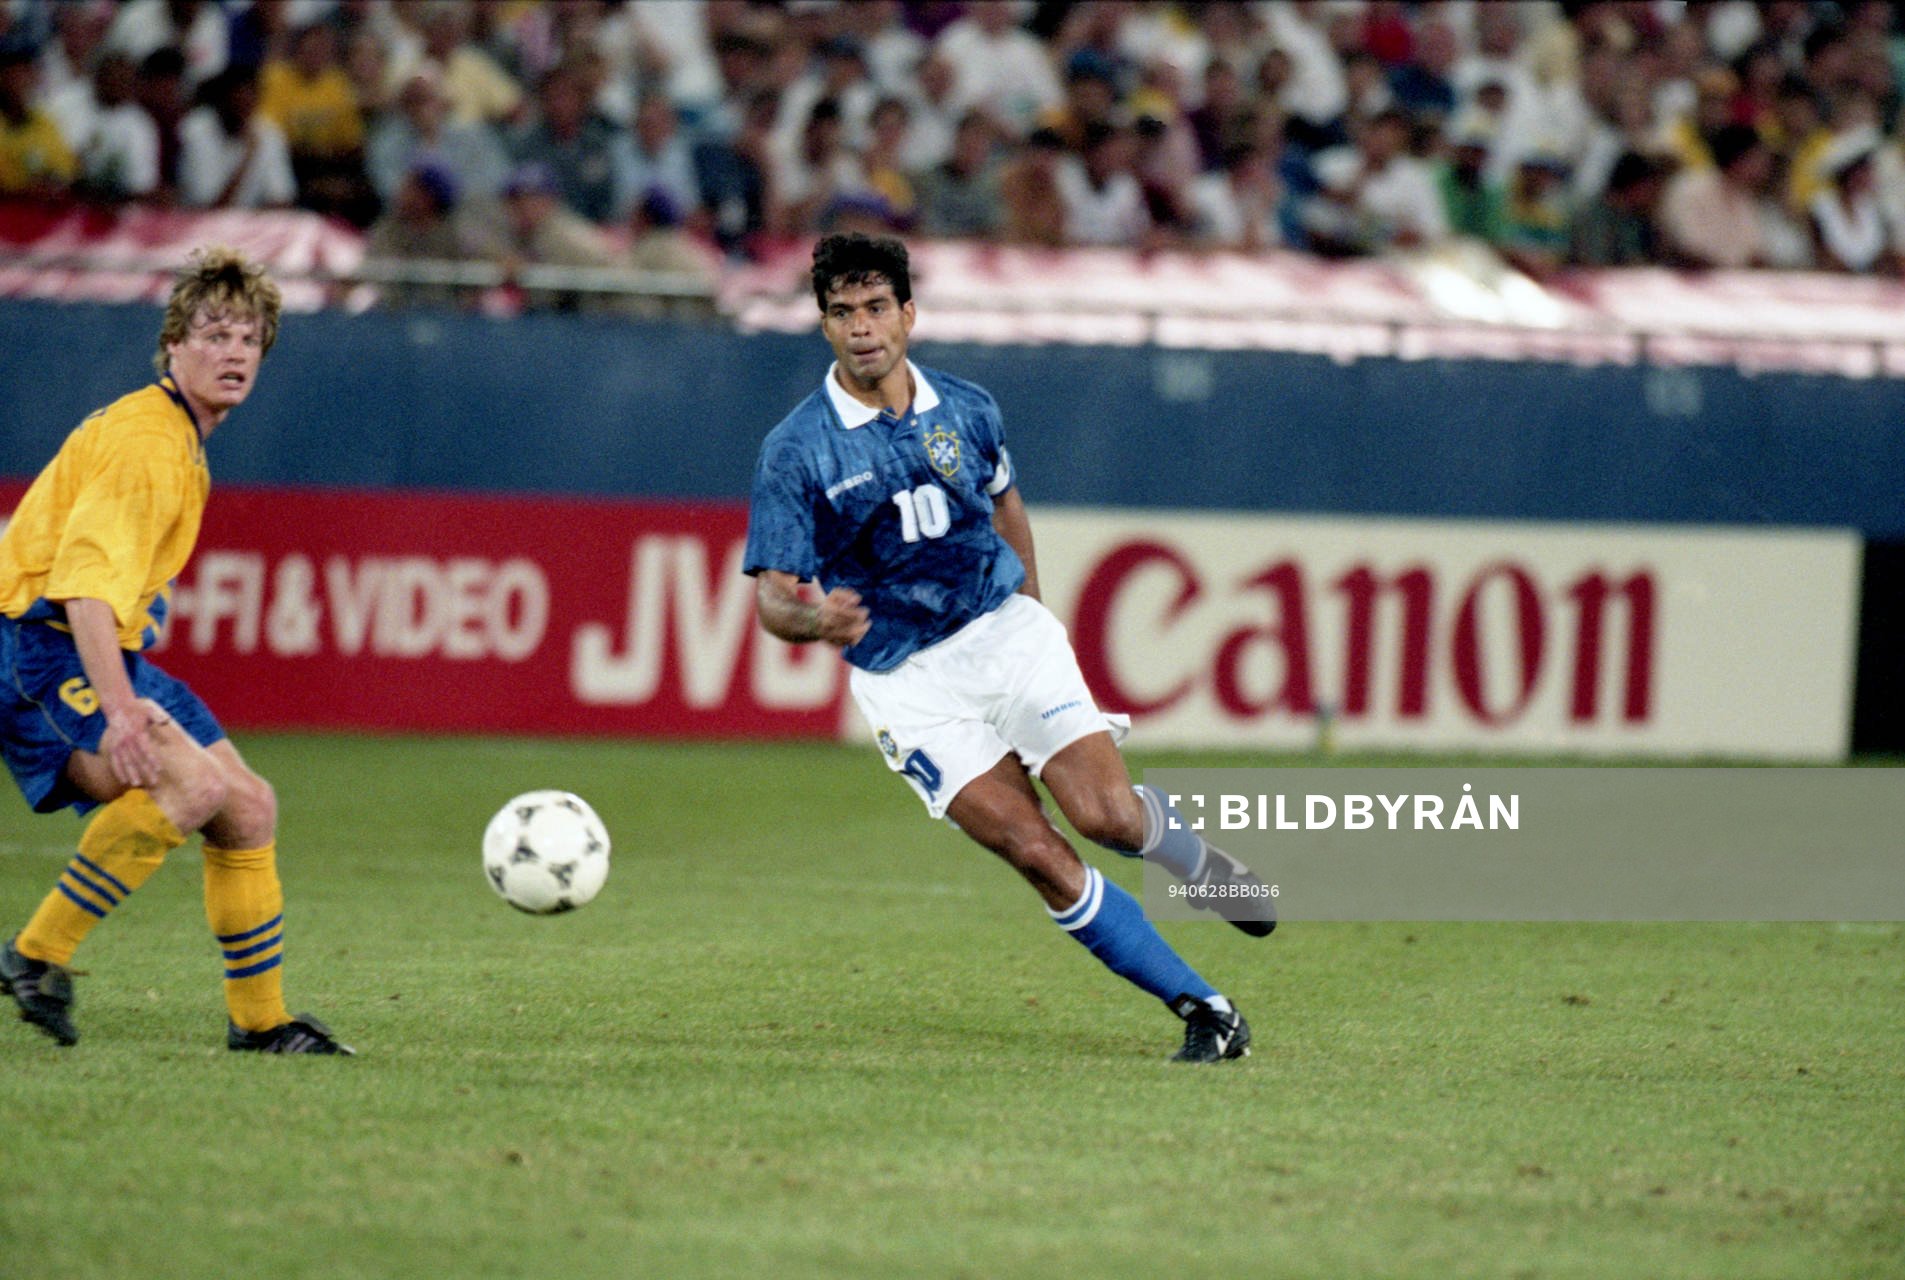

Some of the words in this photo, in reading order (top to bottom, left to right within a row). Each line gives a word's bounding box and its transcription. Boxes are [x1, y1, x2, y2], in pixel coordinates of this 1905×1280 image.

[892, 483, 951, 543] 10
[1072, 537, 1660, 728] Canon
[58, 676, 99, 717] 6
